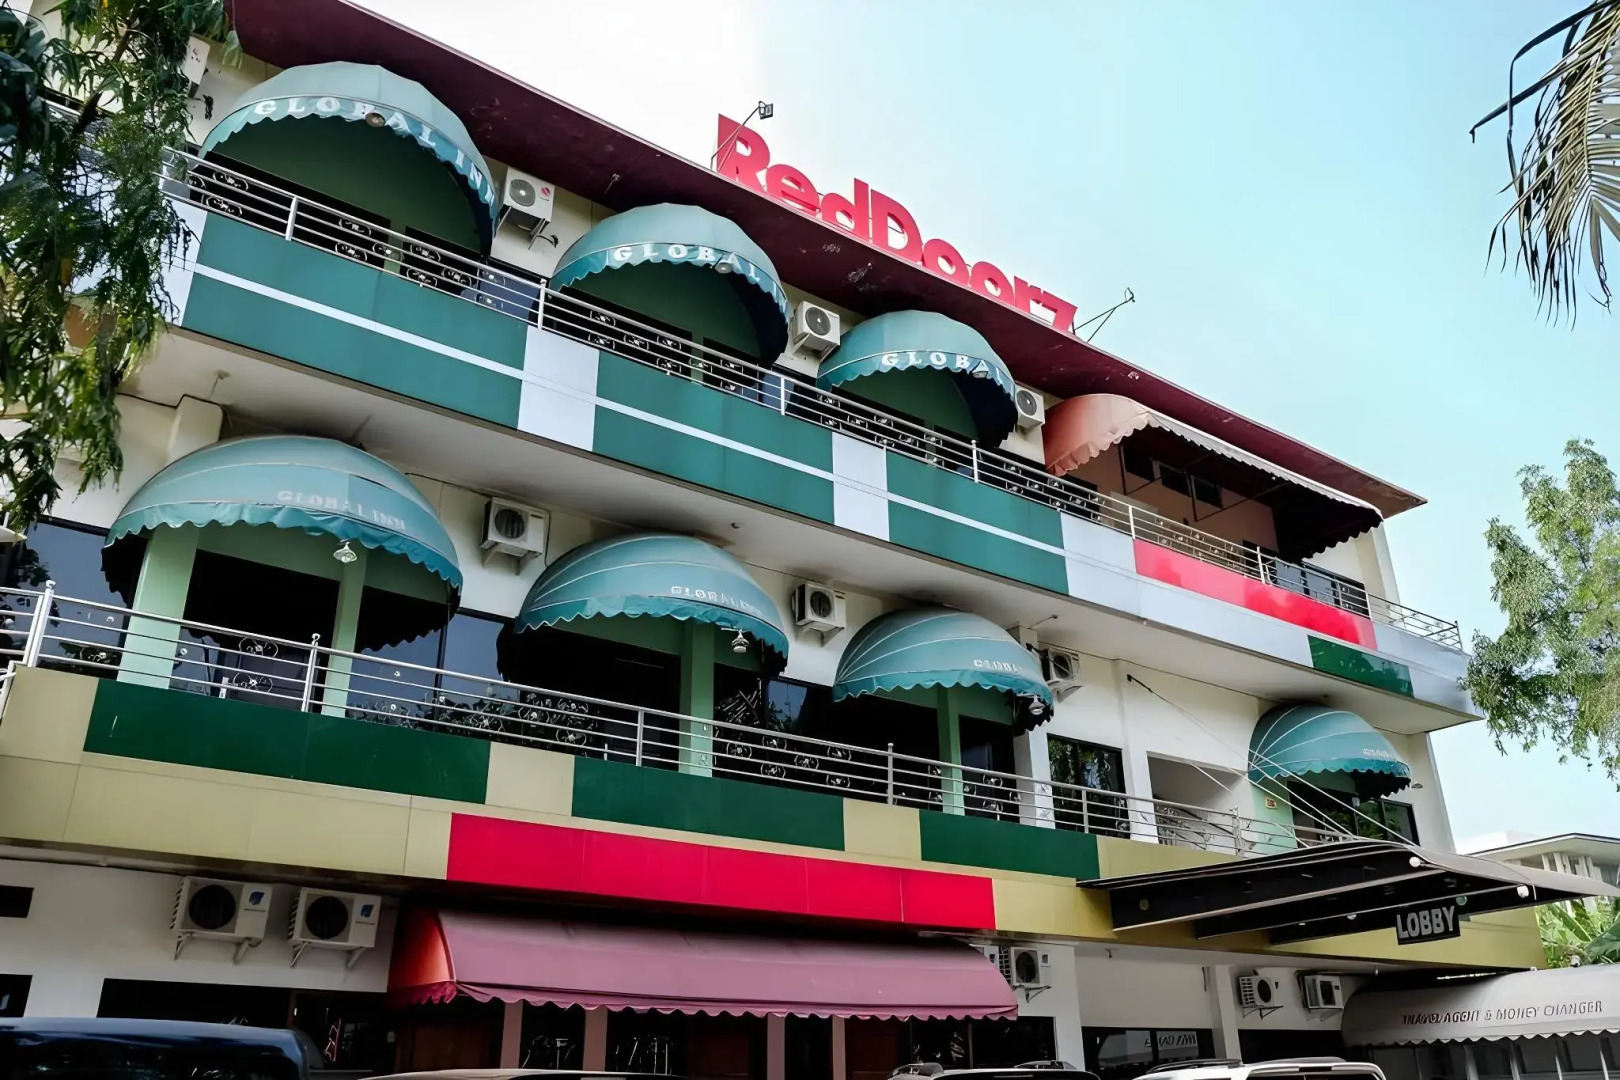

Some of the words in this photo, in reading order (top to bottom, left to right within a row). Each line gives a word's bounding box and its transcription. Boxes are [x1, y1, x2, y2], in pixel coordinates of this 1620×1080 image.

[254, 97, 435, 147] GLOBAL
[717, 113, 1078, 332] RedDoorz
[1397, 905, 1455, 939] LOBBY
[1496, 1006, 1540, 1020] MONEY
[1544, 1000, 1603, 1016] CHANGER
